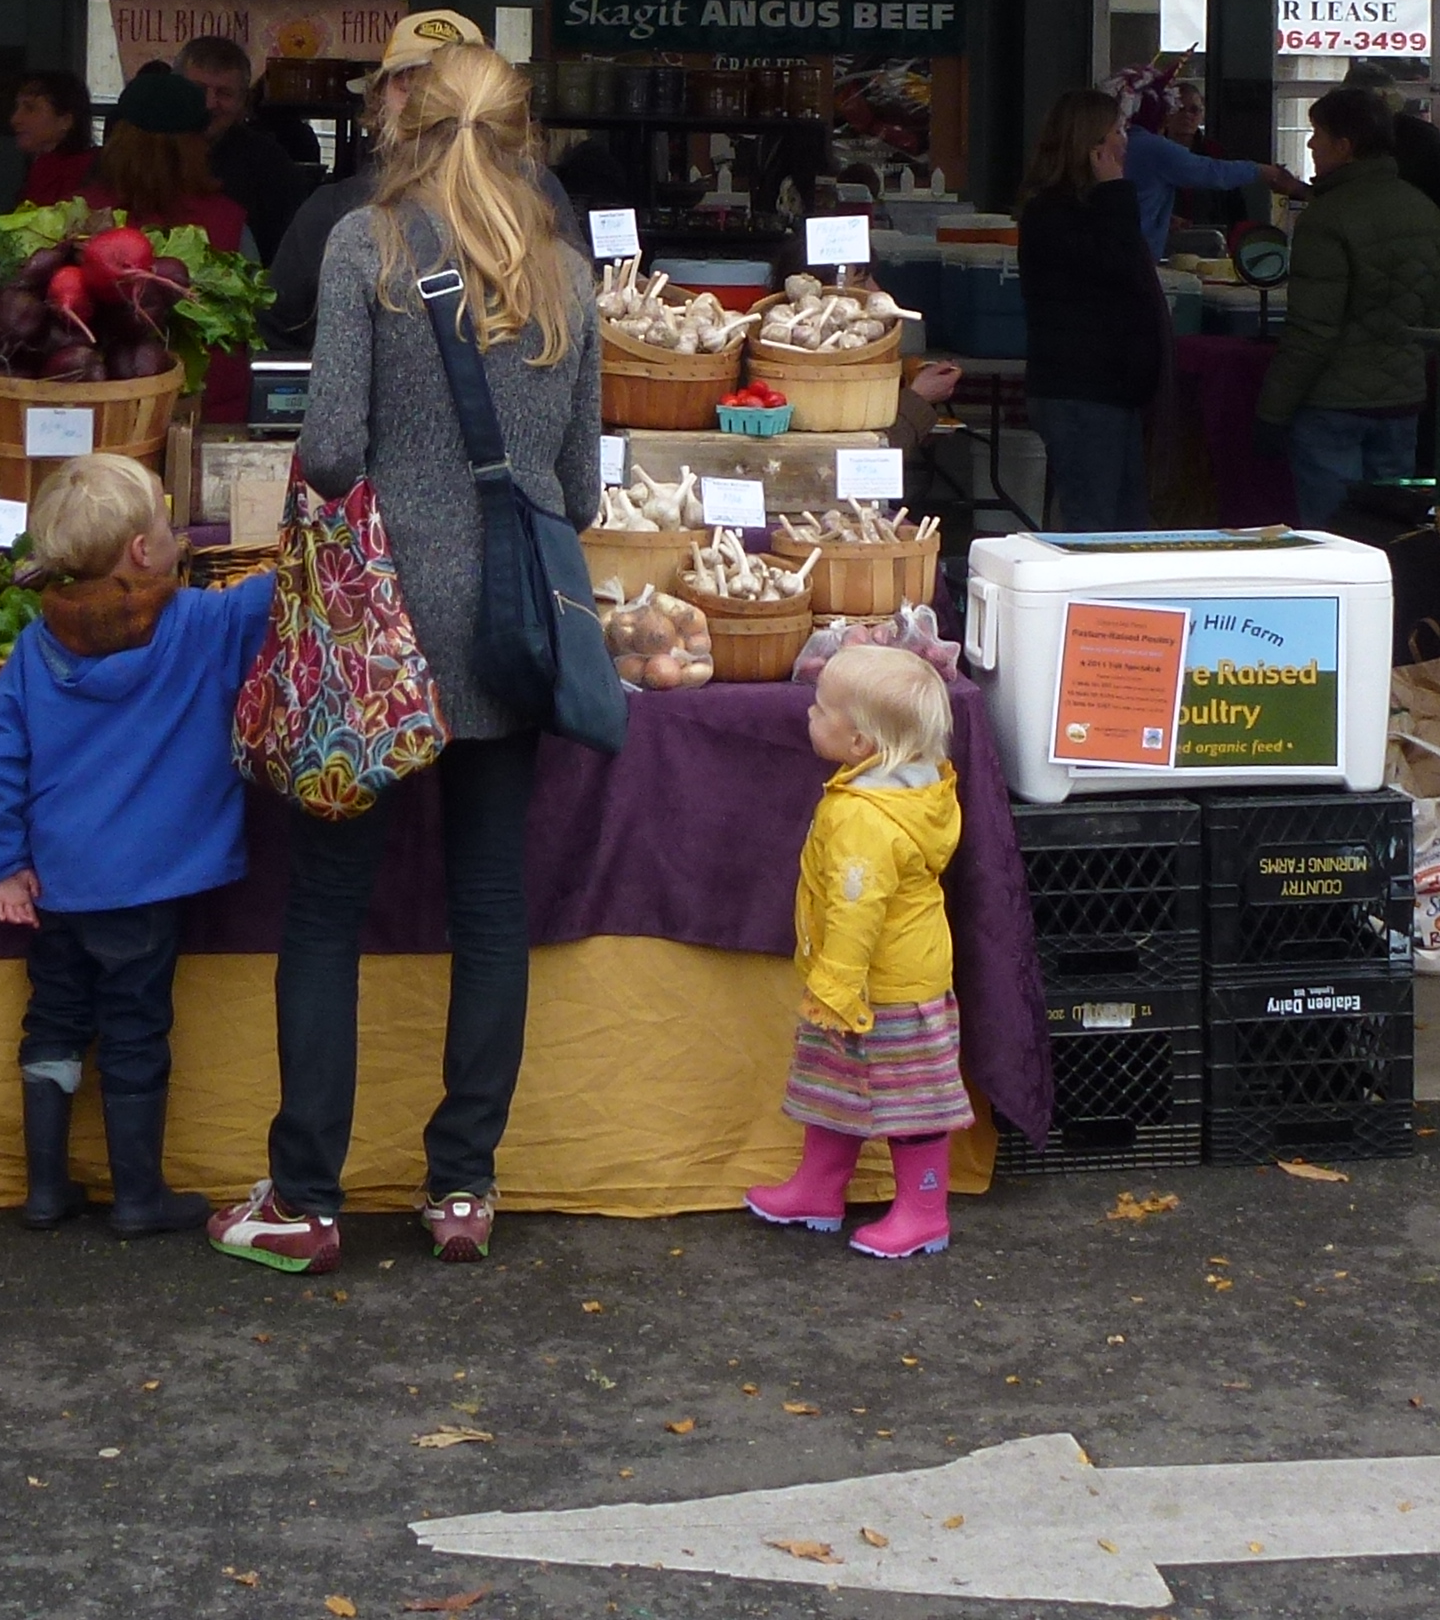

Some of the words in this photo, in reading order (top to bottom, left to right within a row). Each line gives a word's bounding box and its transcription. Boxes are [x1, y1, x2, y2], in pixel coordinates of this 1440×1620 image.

[700, 0, 841, 28] ANGUS
[853, 2, 956, 30] BEEF
[1311, 0, 1398, 22] LEASE
[116, 8, 168, 43] FULL
[174, 7, 250, 42] BLOOM
[342, 9, 399, 44] FARM
[1204, 613, 1235, 631] Hill
[1241, 618, 1284, 648] Farm
[1217, 658, 1318, 686] Raised
[1195, 741, 1247, 757] organic
[1252, 738, 1284, 755] feed
[1260, 857, 1305, 874] FARMS
[1308, 855, 1367, 873] MORNING
[1281, 879, 1342, 896] COUNTRY
[1267, 996, 1303, 1014] Dairy
[1307, 994, 1361, 1011] Edaleen
